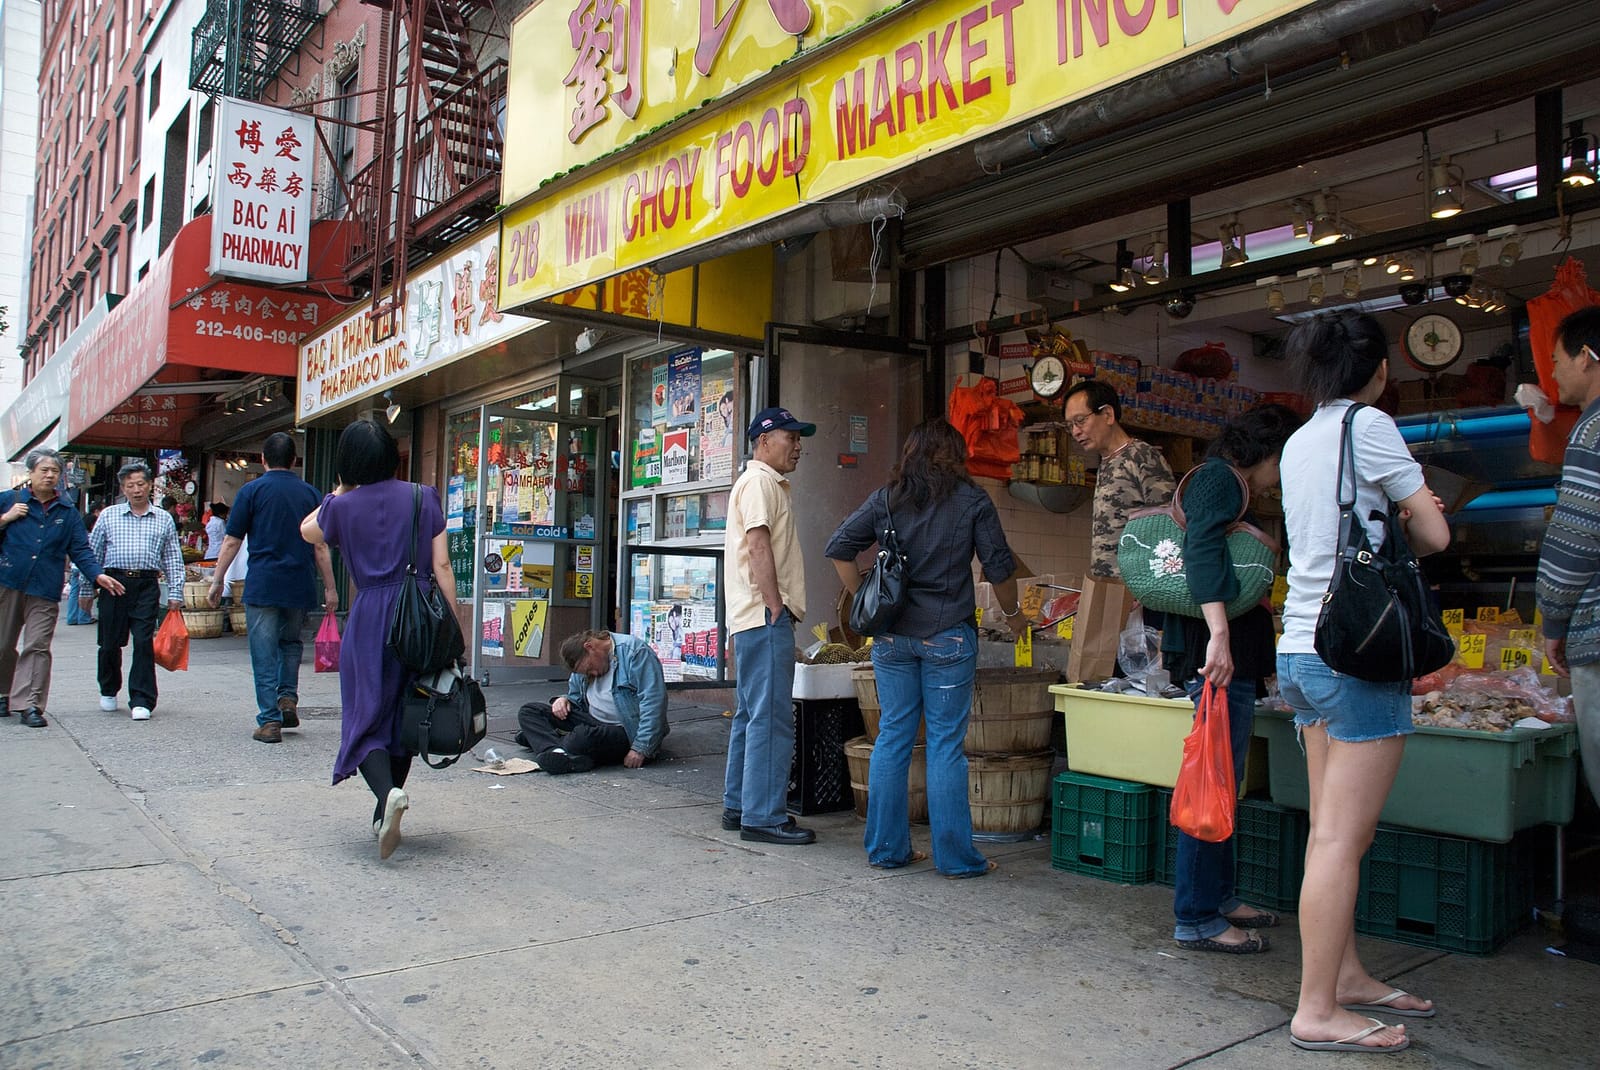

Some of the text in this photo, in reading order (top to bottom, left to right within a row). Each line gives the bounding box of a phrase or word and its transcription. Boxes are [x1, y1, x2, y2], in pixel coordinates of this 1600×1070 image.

[235, 119, 302, 161] 博愛
[507, 220, 540, 287] 218
[565, 186, 609, 266] WIN
[621, 147, 702, 243] CHOY
[714, 97, 811, 209] FOOD
[835, 0, 1024, 161] MARKET
[227, 162, 304, 198] 西藥房
[232, 199, 268, 230] BAC
[222, 232, 303, 270] PHARMACY
[185, 287, 319, 325] 海鮮肉食公司
[306, 338, 327, 382] BAC
[320, 352, 381, 405] PHARMACO
[664, 450, 687, 467] Marlboro
[511, 525, 534, 535] sold
[536, 527, 560, 537] cold
[515, 602, 538, 651] copies
